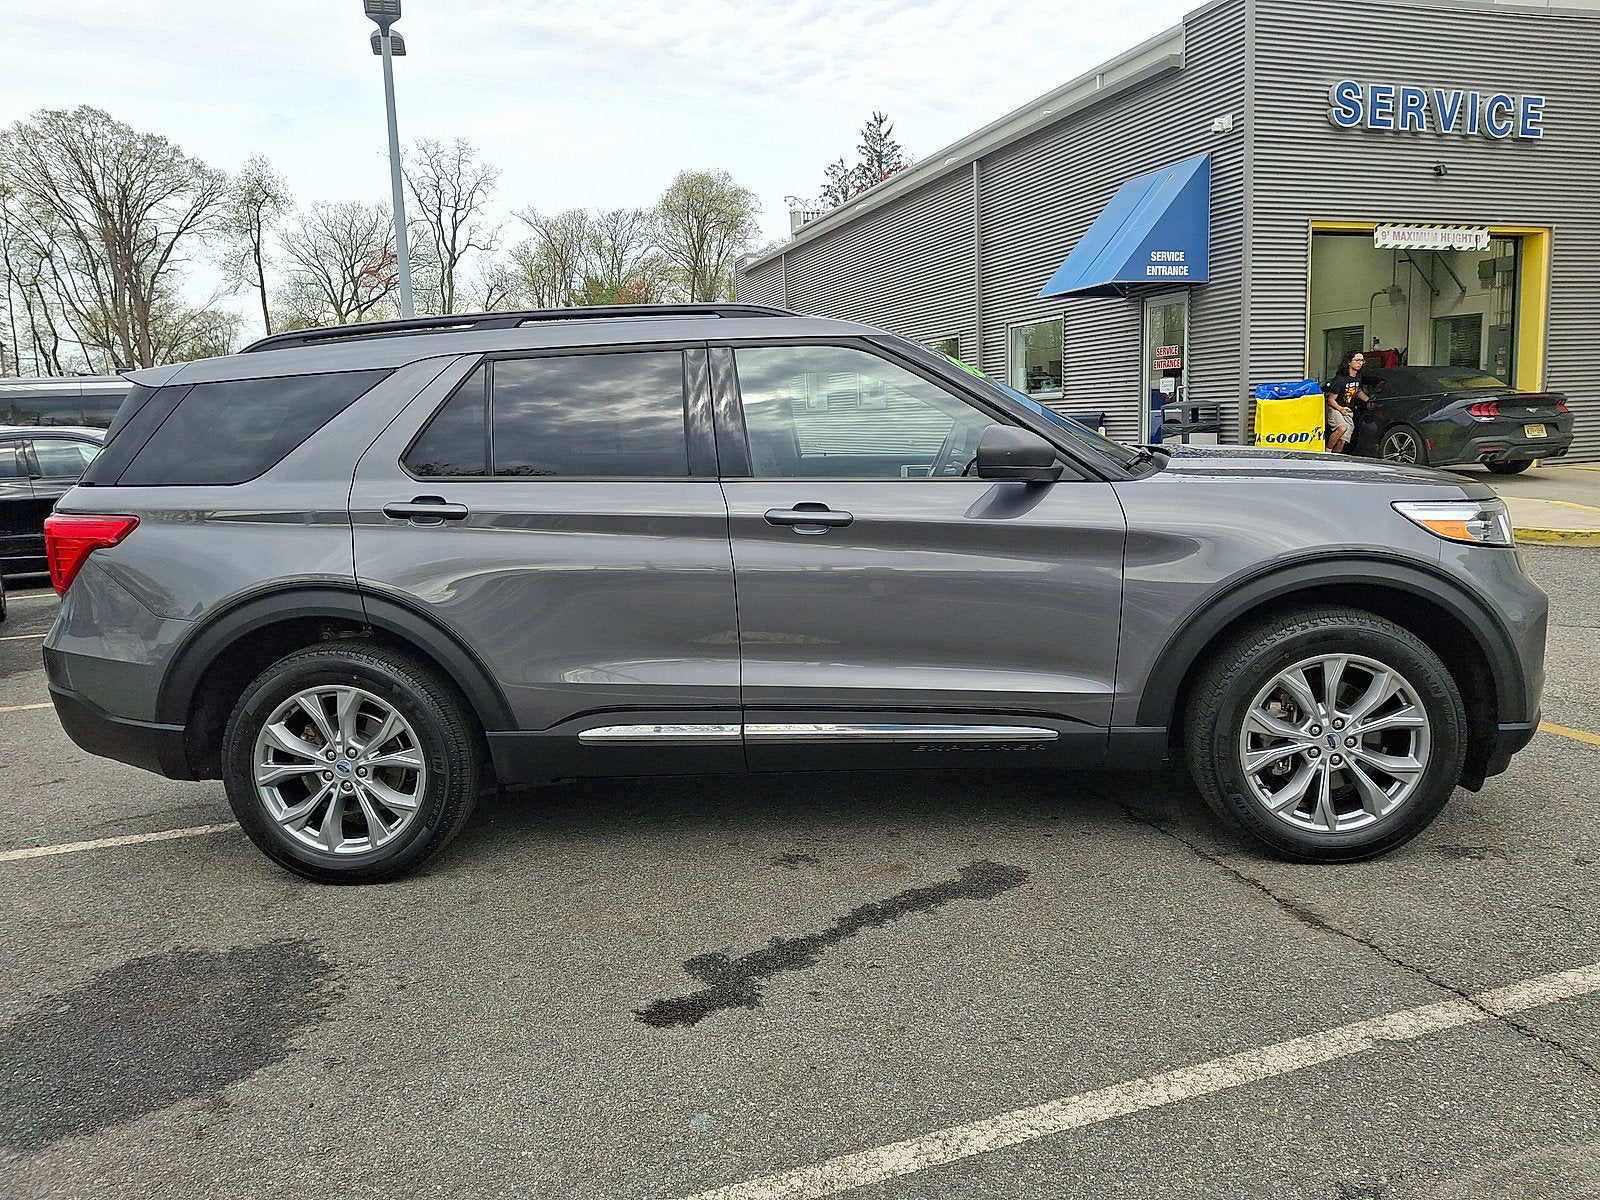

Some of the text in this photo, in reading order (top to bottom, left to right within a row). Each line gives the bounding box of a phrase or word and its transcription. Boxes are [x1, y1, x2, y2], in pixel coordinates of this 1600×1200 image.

[1329, 80, 1546, 138] SERVICE
[1381, 231, 1390, 240] 9'
[1392, 231, 1438, 242] MAXIMUM
[1440, 232, 1474, 244] HEIGHT
[1150, 251, 1185, 261] SERVICE
[1146, 265, 1189, 276] ENTRANCE
[1156, 345, 1178, 357] SERVICE
[1153, 358, 1181, 370] ENTRANCE
